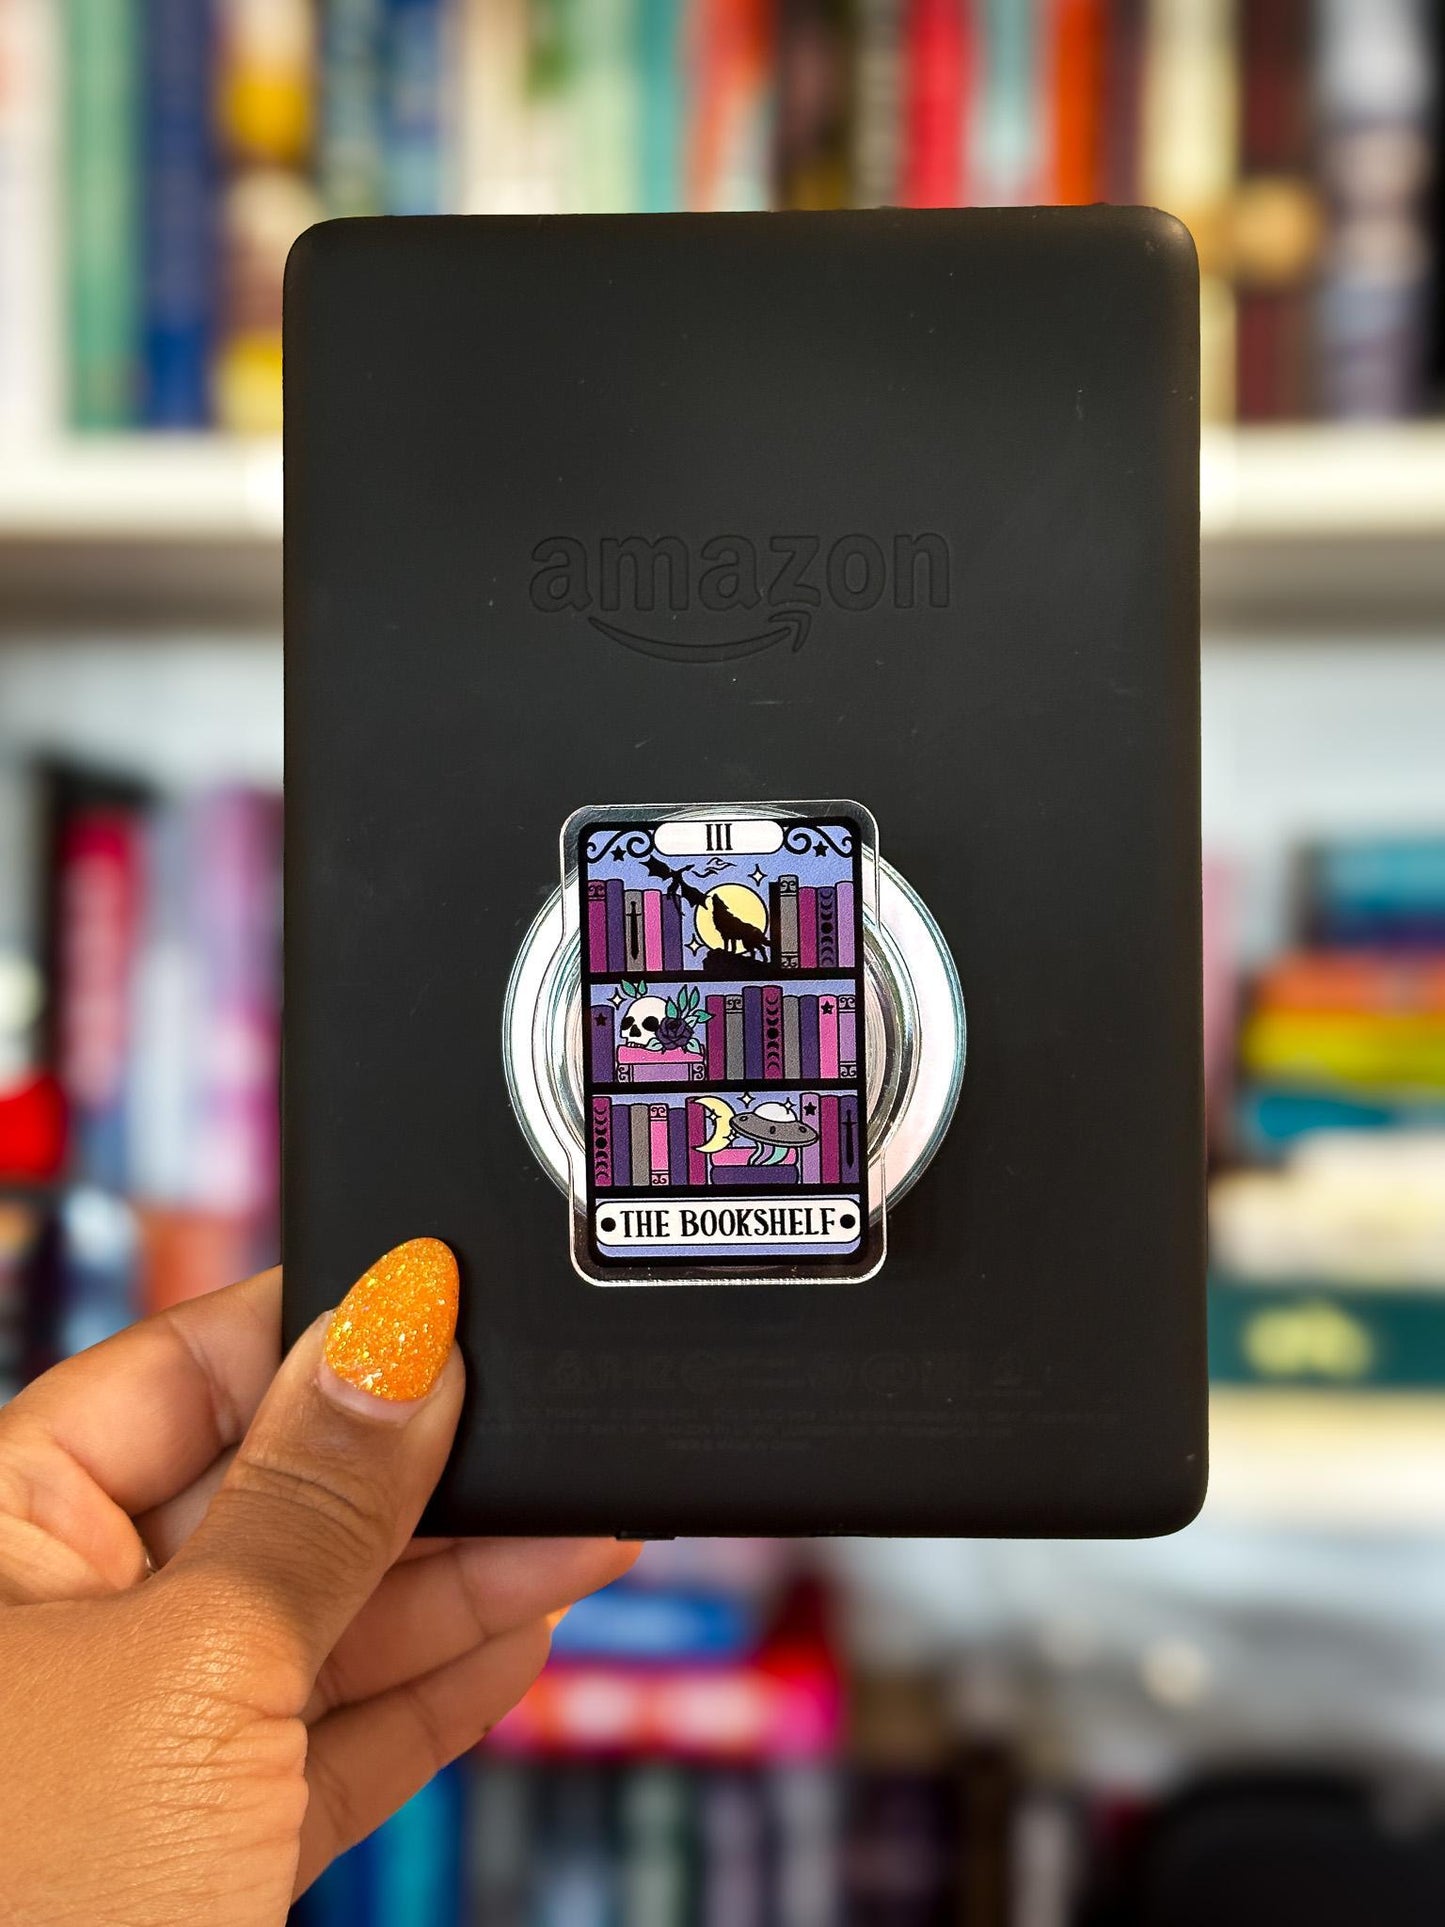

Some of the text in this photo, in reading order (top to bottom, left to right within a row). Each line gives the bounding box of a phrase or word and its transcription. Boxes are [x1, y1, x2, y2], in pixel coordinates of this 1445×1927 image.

[529, 533, 950, 613] amazon
[705, 823, 733, 851] III
[620, 1207, 836, 1238] THE BOOKSHELF
